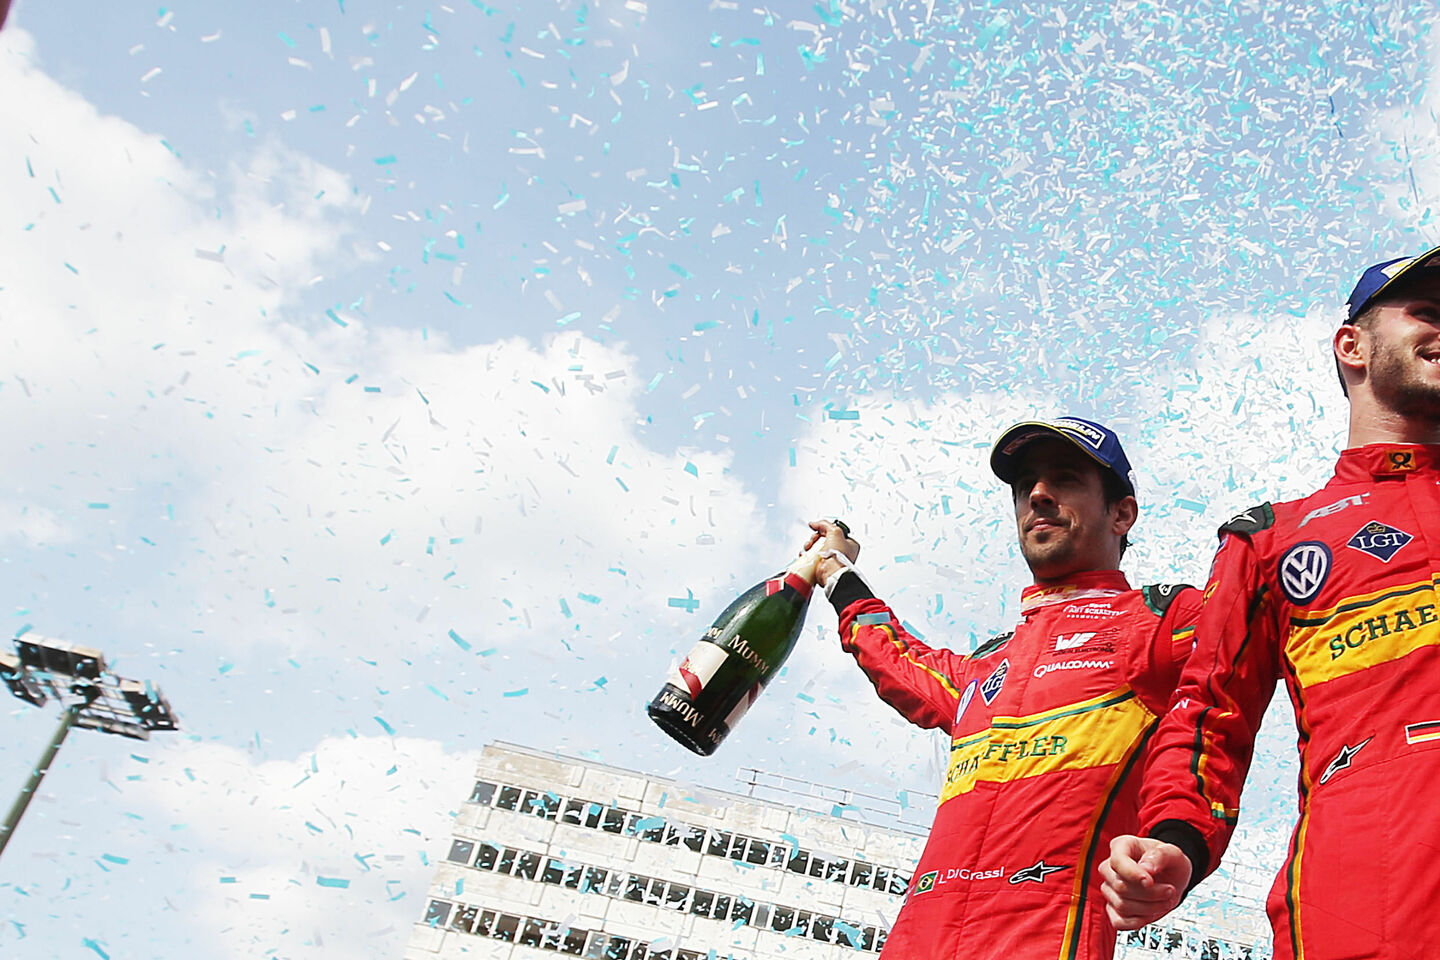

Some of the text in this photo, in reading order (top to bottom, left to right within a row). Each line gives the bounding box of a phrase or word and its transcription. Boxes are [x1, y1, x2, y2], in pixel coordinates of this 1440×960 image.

[1356, 533, 1404, 549] LGT
[727, 634, 770, 675] MUMM
[1055, 632, 1097, 651] WE
[1033, 660, 1110, 678] QUALCOMM
[659, 691, 704, 728] MUMM
[947, 735, 1069, 783] SCHAFFLER
